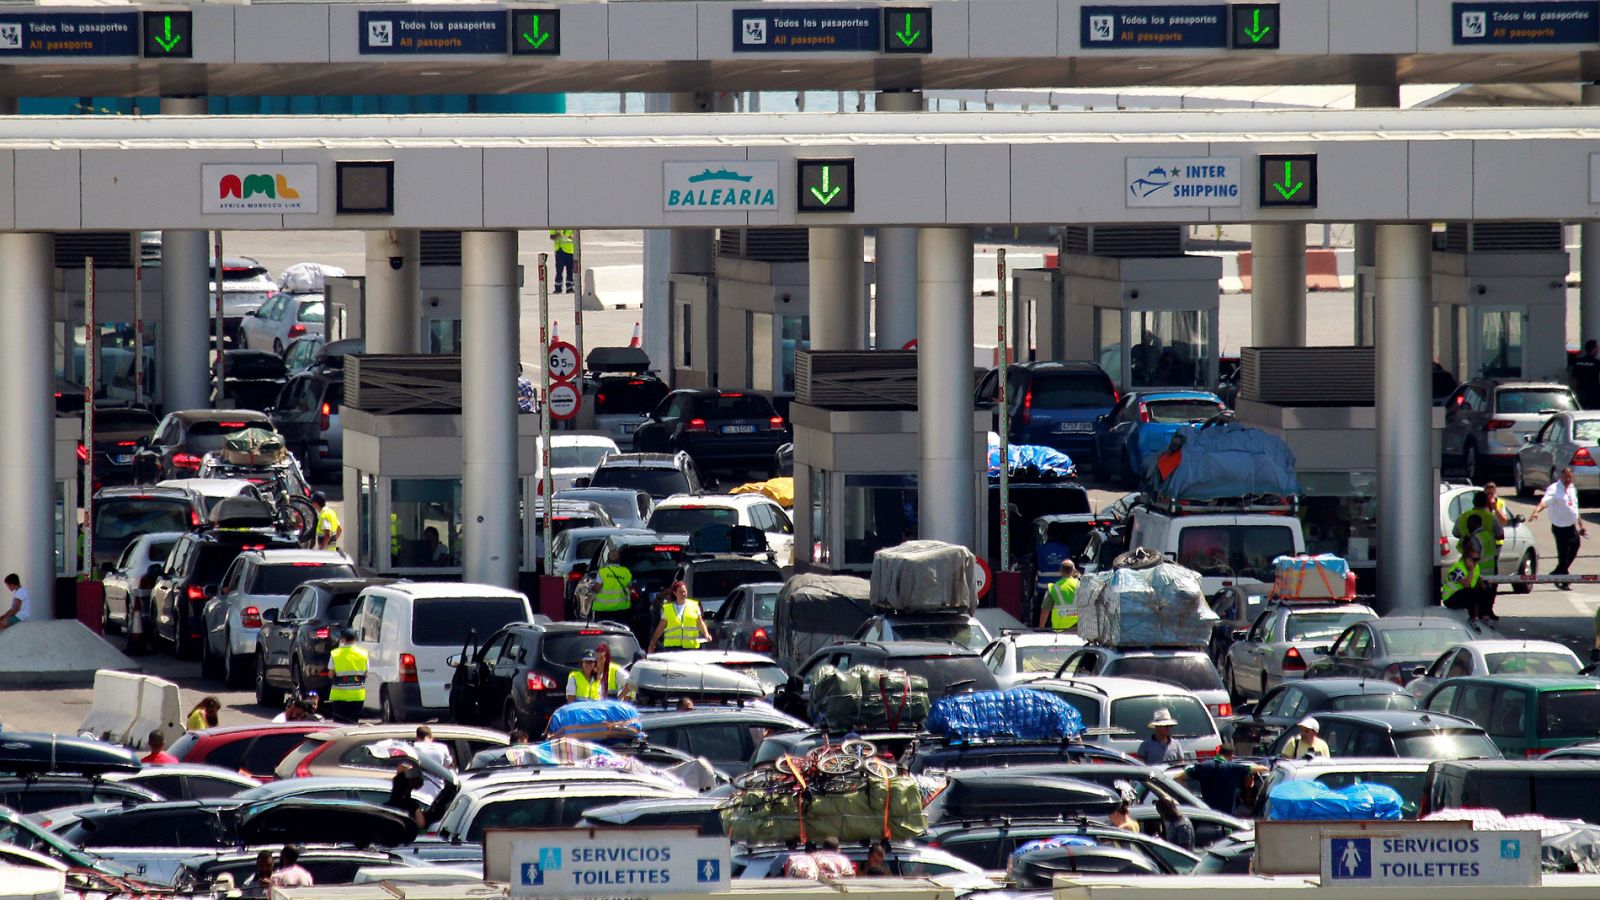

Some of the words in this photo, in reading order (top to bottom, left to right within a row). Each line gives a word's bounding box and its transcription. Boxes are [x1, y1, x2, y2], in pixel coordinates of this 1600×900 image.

[1121, 16, 1147, 25] Todos
[1151, 16, 1164, 25] los
[1169, 15, 1217, 27] pasaportes
[1492, 12, 1520, 21] Todos
[1523, 11, 1536, 21] los
[1540, 11, 1589, 23] pasaportes
[29, 23, 56, 33] Todos
[61, 23, 74, 33] los
[79, 23, 128, 35] pasaportes
[400, 21, 426, 31] Todos
[430, 21, 444, 31] los
[448, 21, 496, 32] pasaportes
[774, 19, 799, 28] Todos
[803, 19, 817, 28] los
[821, 19, 869, 30] pasaportes
[1121, 32, 1133, 41] All
[1137, 32, 1182, 43] passports
[1493, 28, 1505, 37] All
[1510, 28, 1555, 39] passports
[30, 40, 42, 49] All
[47, 40, 94, 51] passports
[400, 37, 413, 47] All
[417, 38, 462, 49] passports
[774, 35, 786, 44] All
[791, 35, 835, 46] passports
[1186, 165, 1226, 178] INTER
[219, 173, 300, 200] AML
[1173, 184, 1238, 198] SHIPPING
[1383, 838, 1480, 853] SERVICIOS
[571, 847, 671, 863] SERVICIOS
[1380, 862, 1480, 878] TOILETTES
[572, 869, 671, 885] TOILETTES
